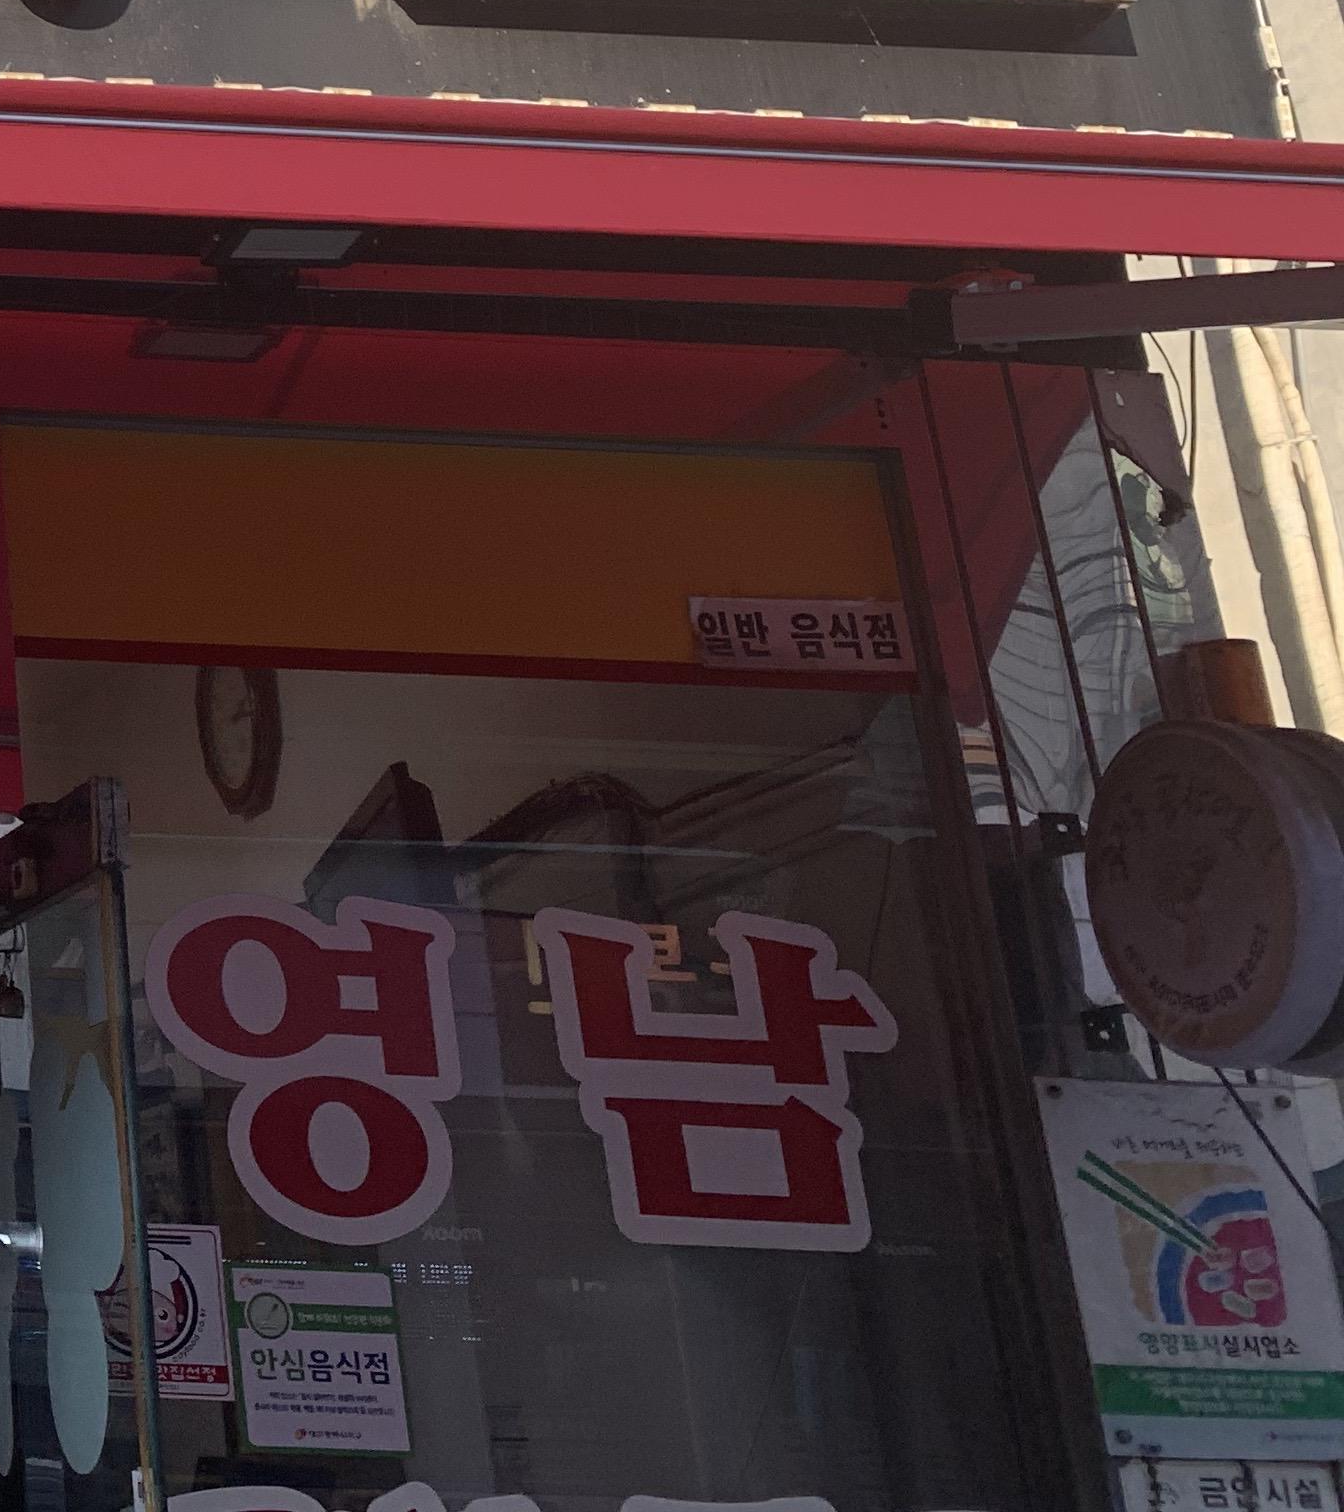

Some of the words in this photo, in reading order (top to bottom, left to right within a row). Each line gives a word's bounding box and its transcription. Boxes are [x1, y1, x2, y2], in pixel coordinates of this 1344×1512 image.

[696, 605, 772, 660] 일반
[788, 609, 904, 665] 음식점
[146, 894, 898, 1252] 영남
[250, 1348, 391, 1385] 안심음식점
